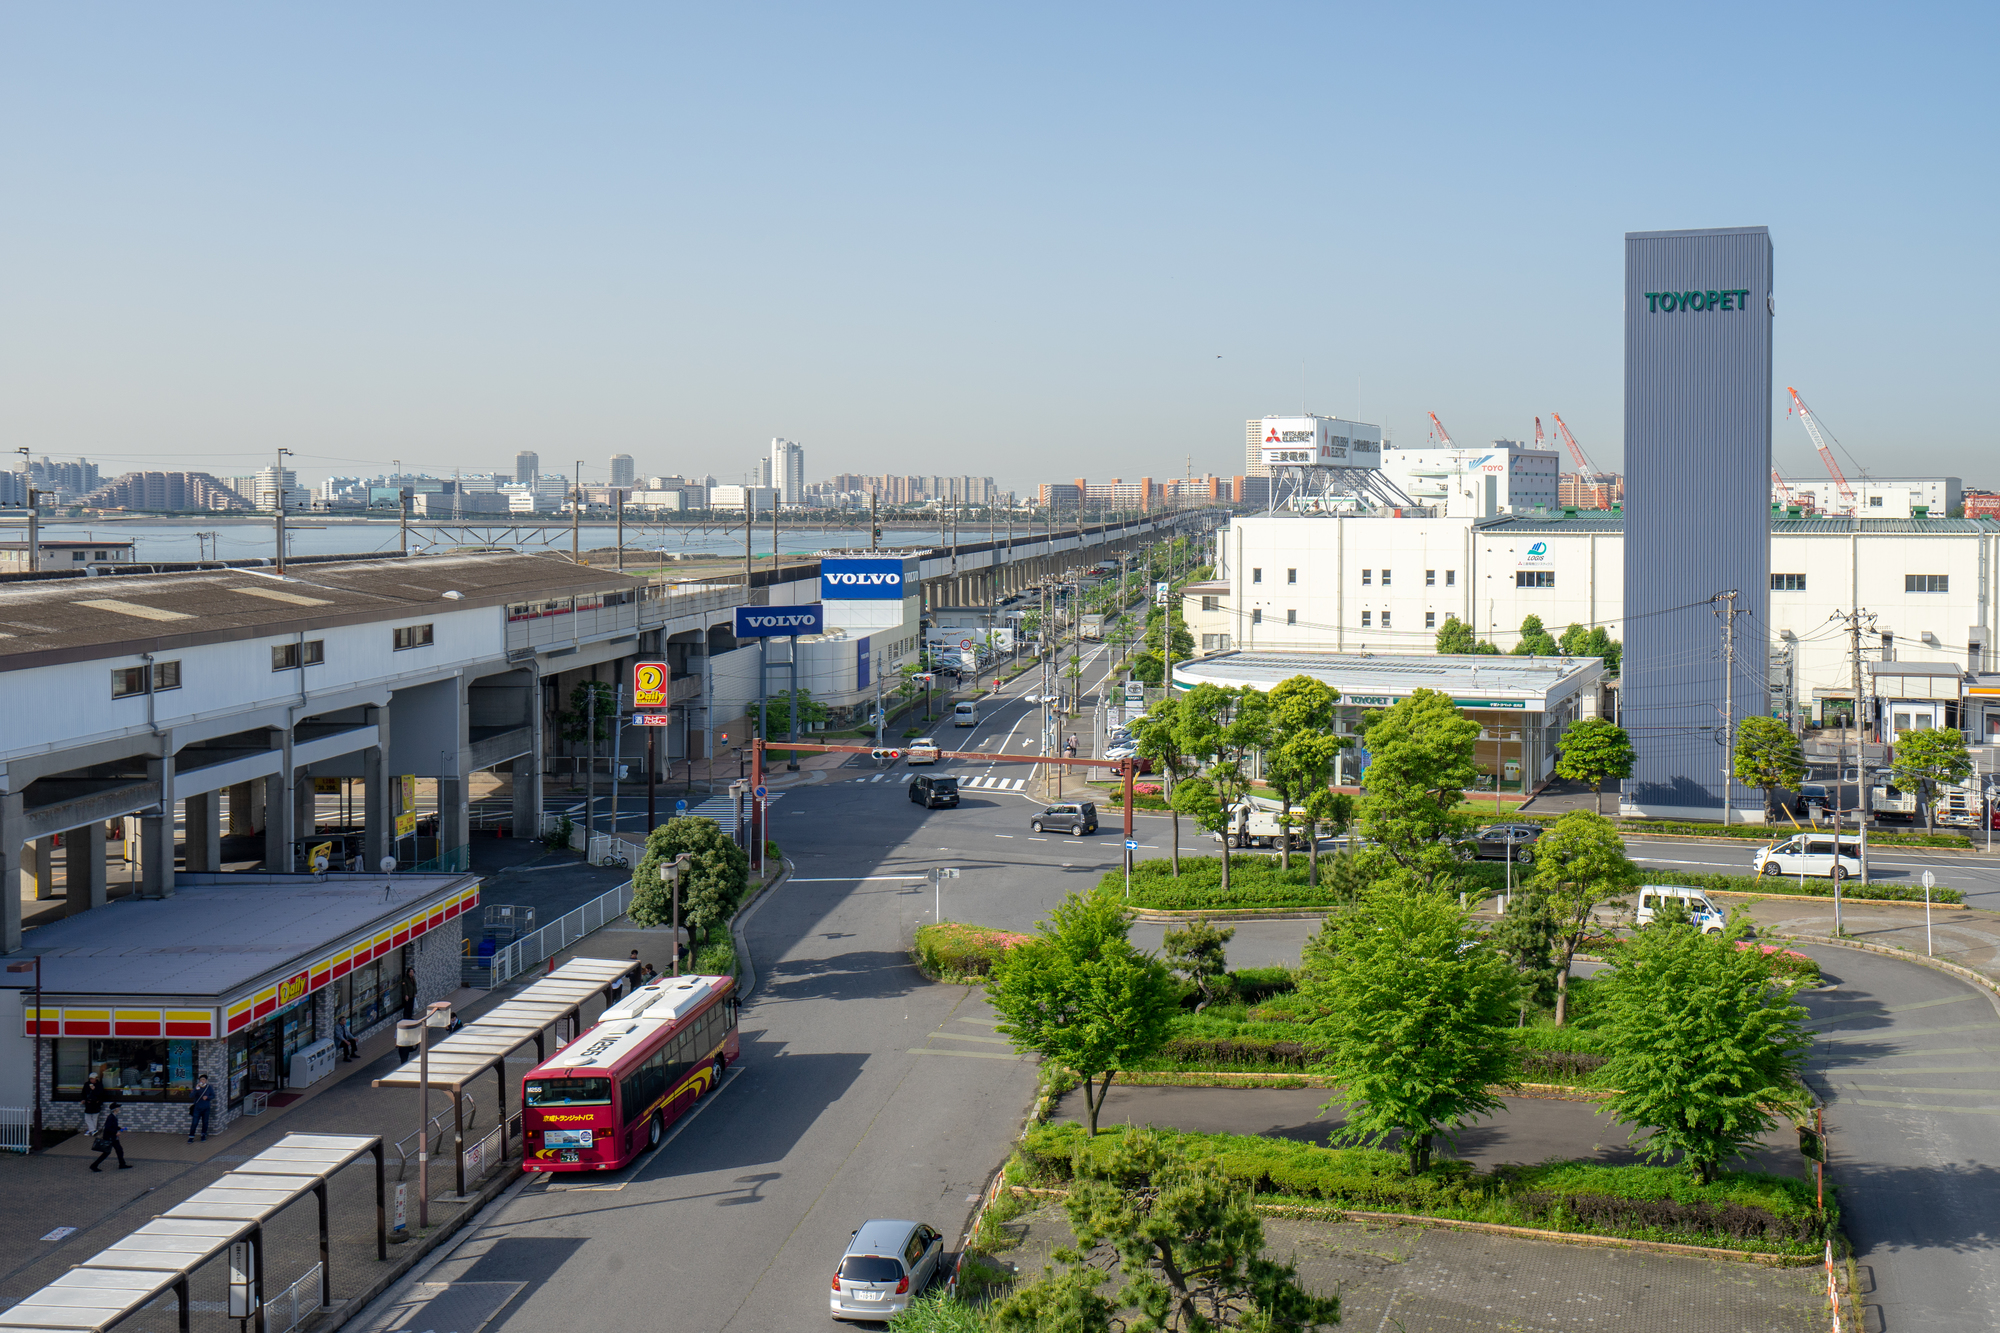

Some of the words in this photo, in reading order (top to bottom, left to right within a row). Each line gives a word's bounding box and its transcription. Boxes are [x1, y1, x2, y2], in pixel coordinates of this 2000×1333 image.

[1644, 289, 1748, 312] TOYOPET
[1331, 435, 1349, 447] MITSUBISHI
[1270, 451, 1310, 462] 三菱電機
[1331, 447, 1347, 458] ELECTRIC
[824, 573, 901, 585] VOLVO
[905, 570, 919, 584] VOLVO
[745, 614, 816, 628] VOLVO
[636, 690, 666, 704] Daily
[1349, 695, 1389, 705] TOYOPET
[634, 716, 644, 725] 酒
[644, 716, 666, 725] たばこ
[280, 975, 308, 1005] Daily
[174, 1044, 187, 1080] 冷し麺
[543, 1113, 594, 1122] 京成トランジットバス
